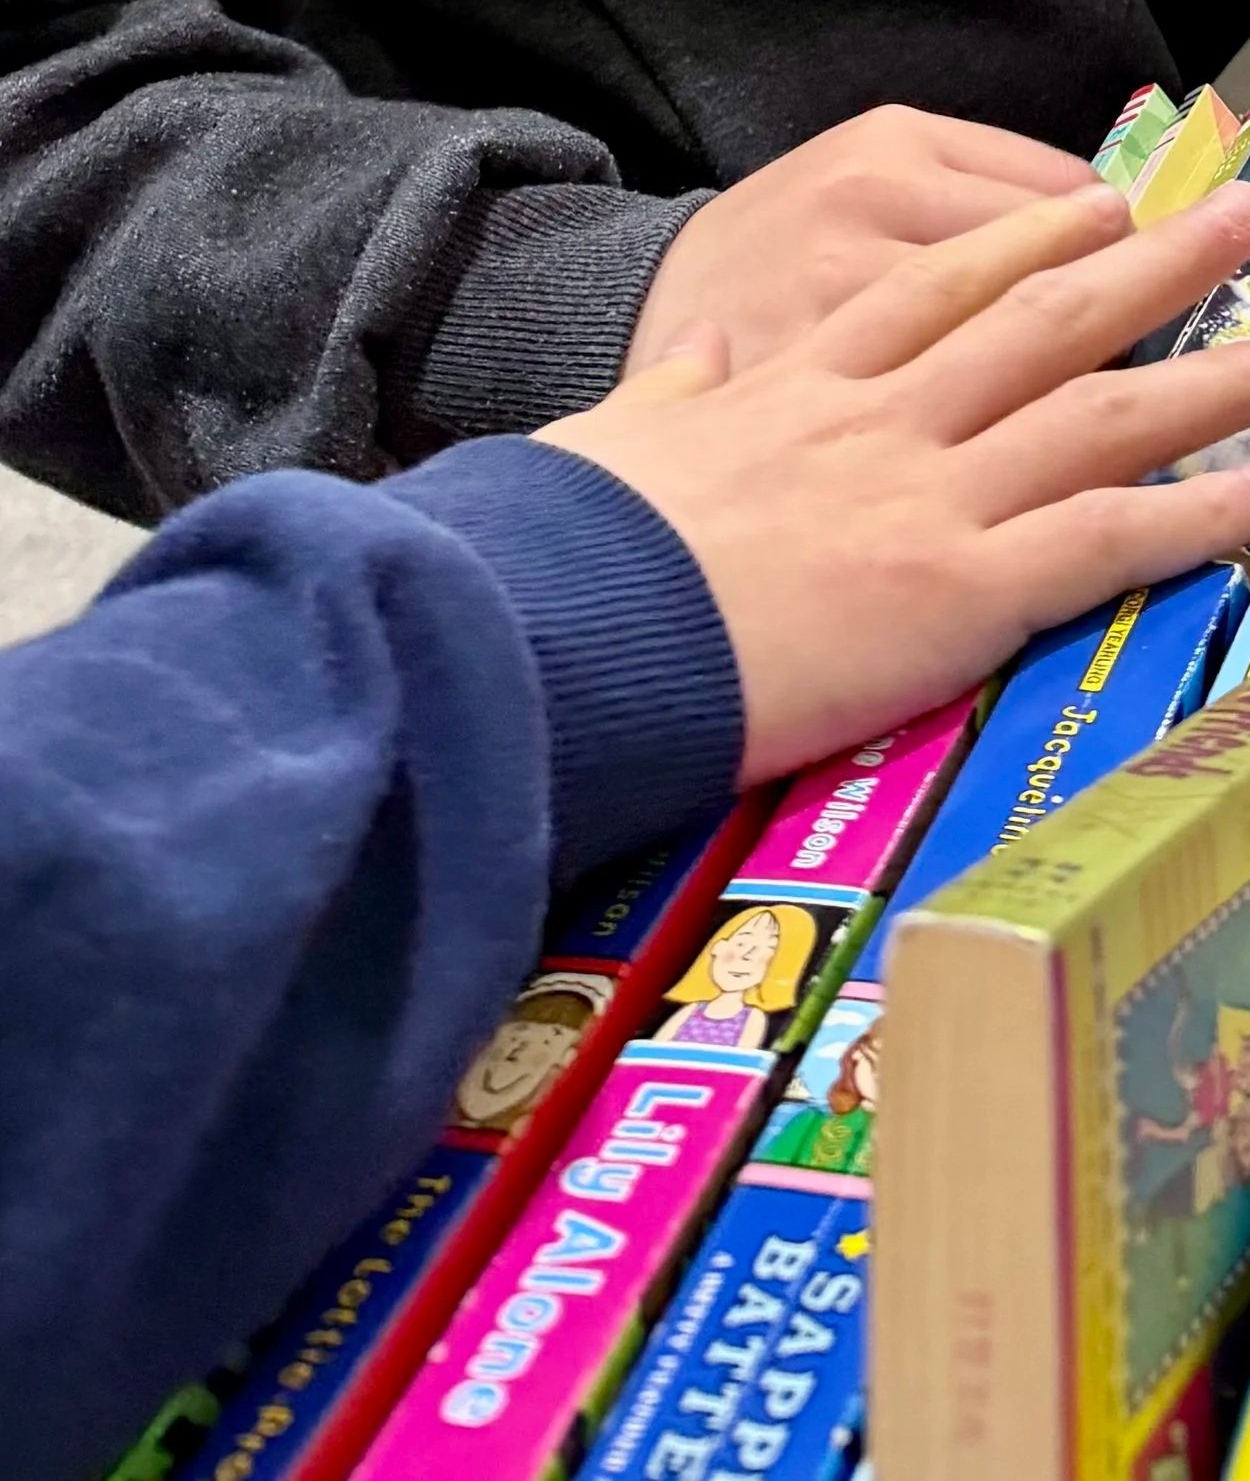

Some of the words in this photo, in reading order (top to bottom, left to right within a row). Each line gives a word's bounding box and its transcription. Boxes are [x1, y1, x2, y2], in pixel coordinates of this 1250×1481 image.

[1084, 620, 1128, 686] YEARLING
[789, 777, 880, 869] Wilson
[560, 1082, 714, 1202] Lily
[380, 1174, 452, 1246] The
[277, 1256, 394, 1390] Lottie
[440, 1208, 628, 1429] Alone
[709, 1270, 863, 1481] SAPP
